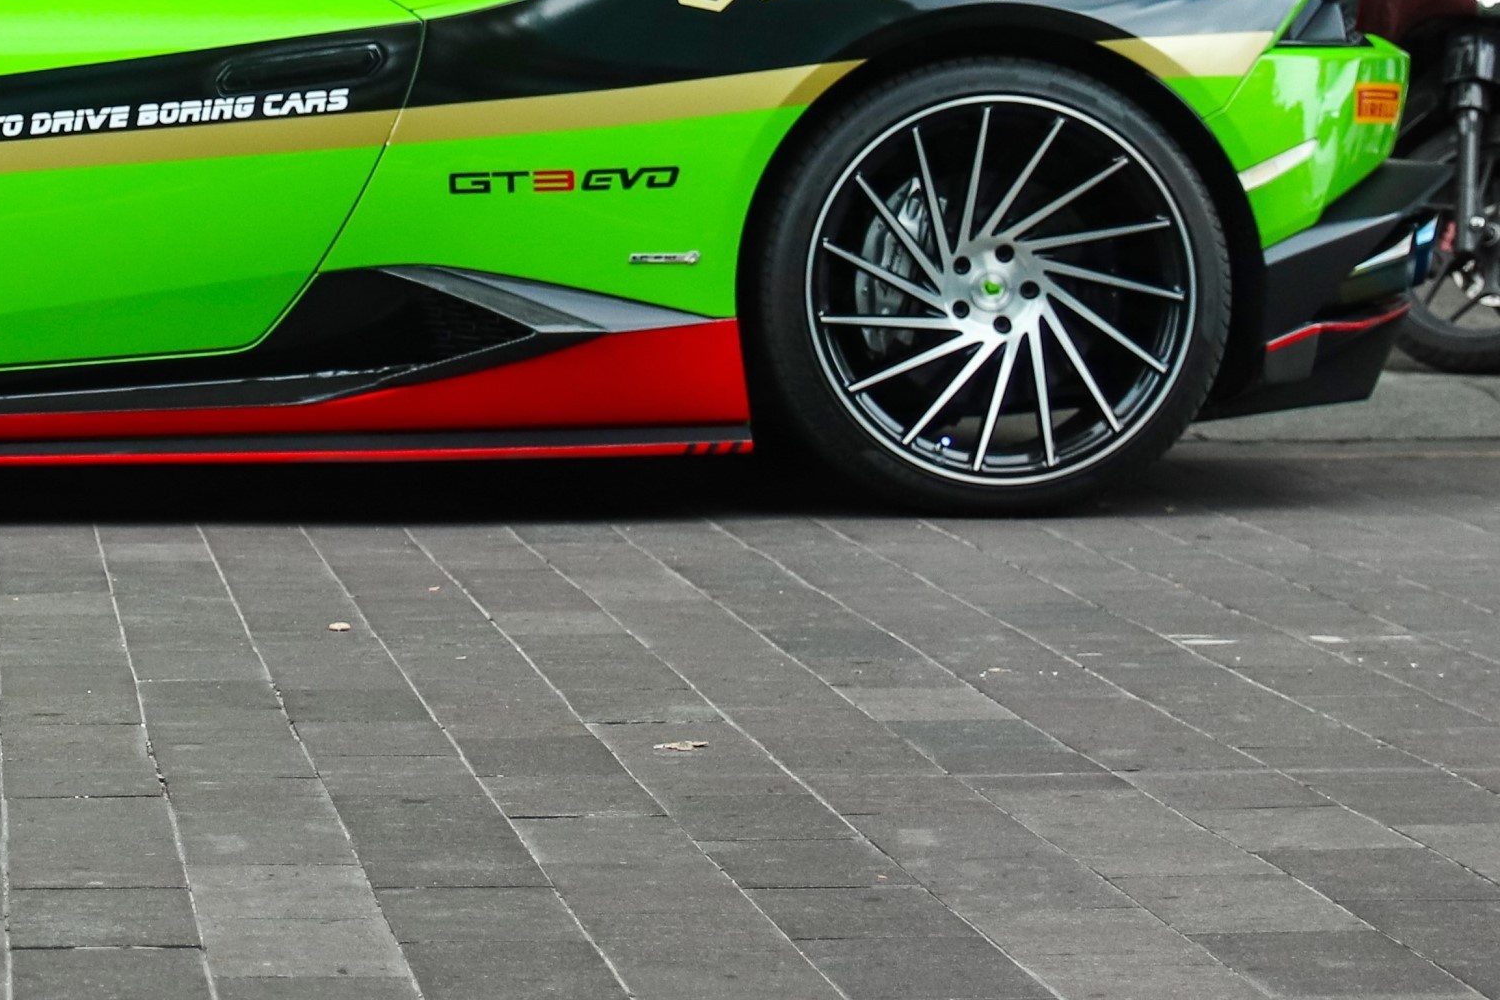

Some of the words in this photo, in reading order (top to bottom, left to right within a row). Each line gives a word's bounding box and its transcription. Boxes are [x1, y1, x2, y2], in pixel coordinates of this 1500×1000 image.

[29, 105, 131, 136] DRIVE
[136, 95, 256, 127] BORING
[262, 88, 350, 119] CARS
[449, 169, 575, 194] GT3
[581, 166, 680, 191] EVO
